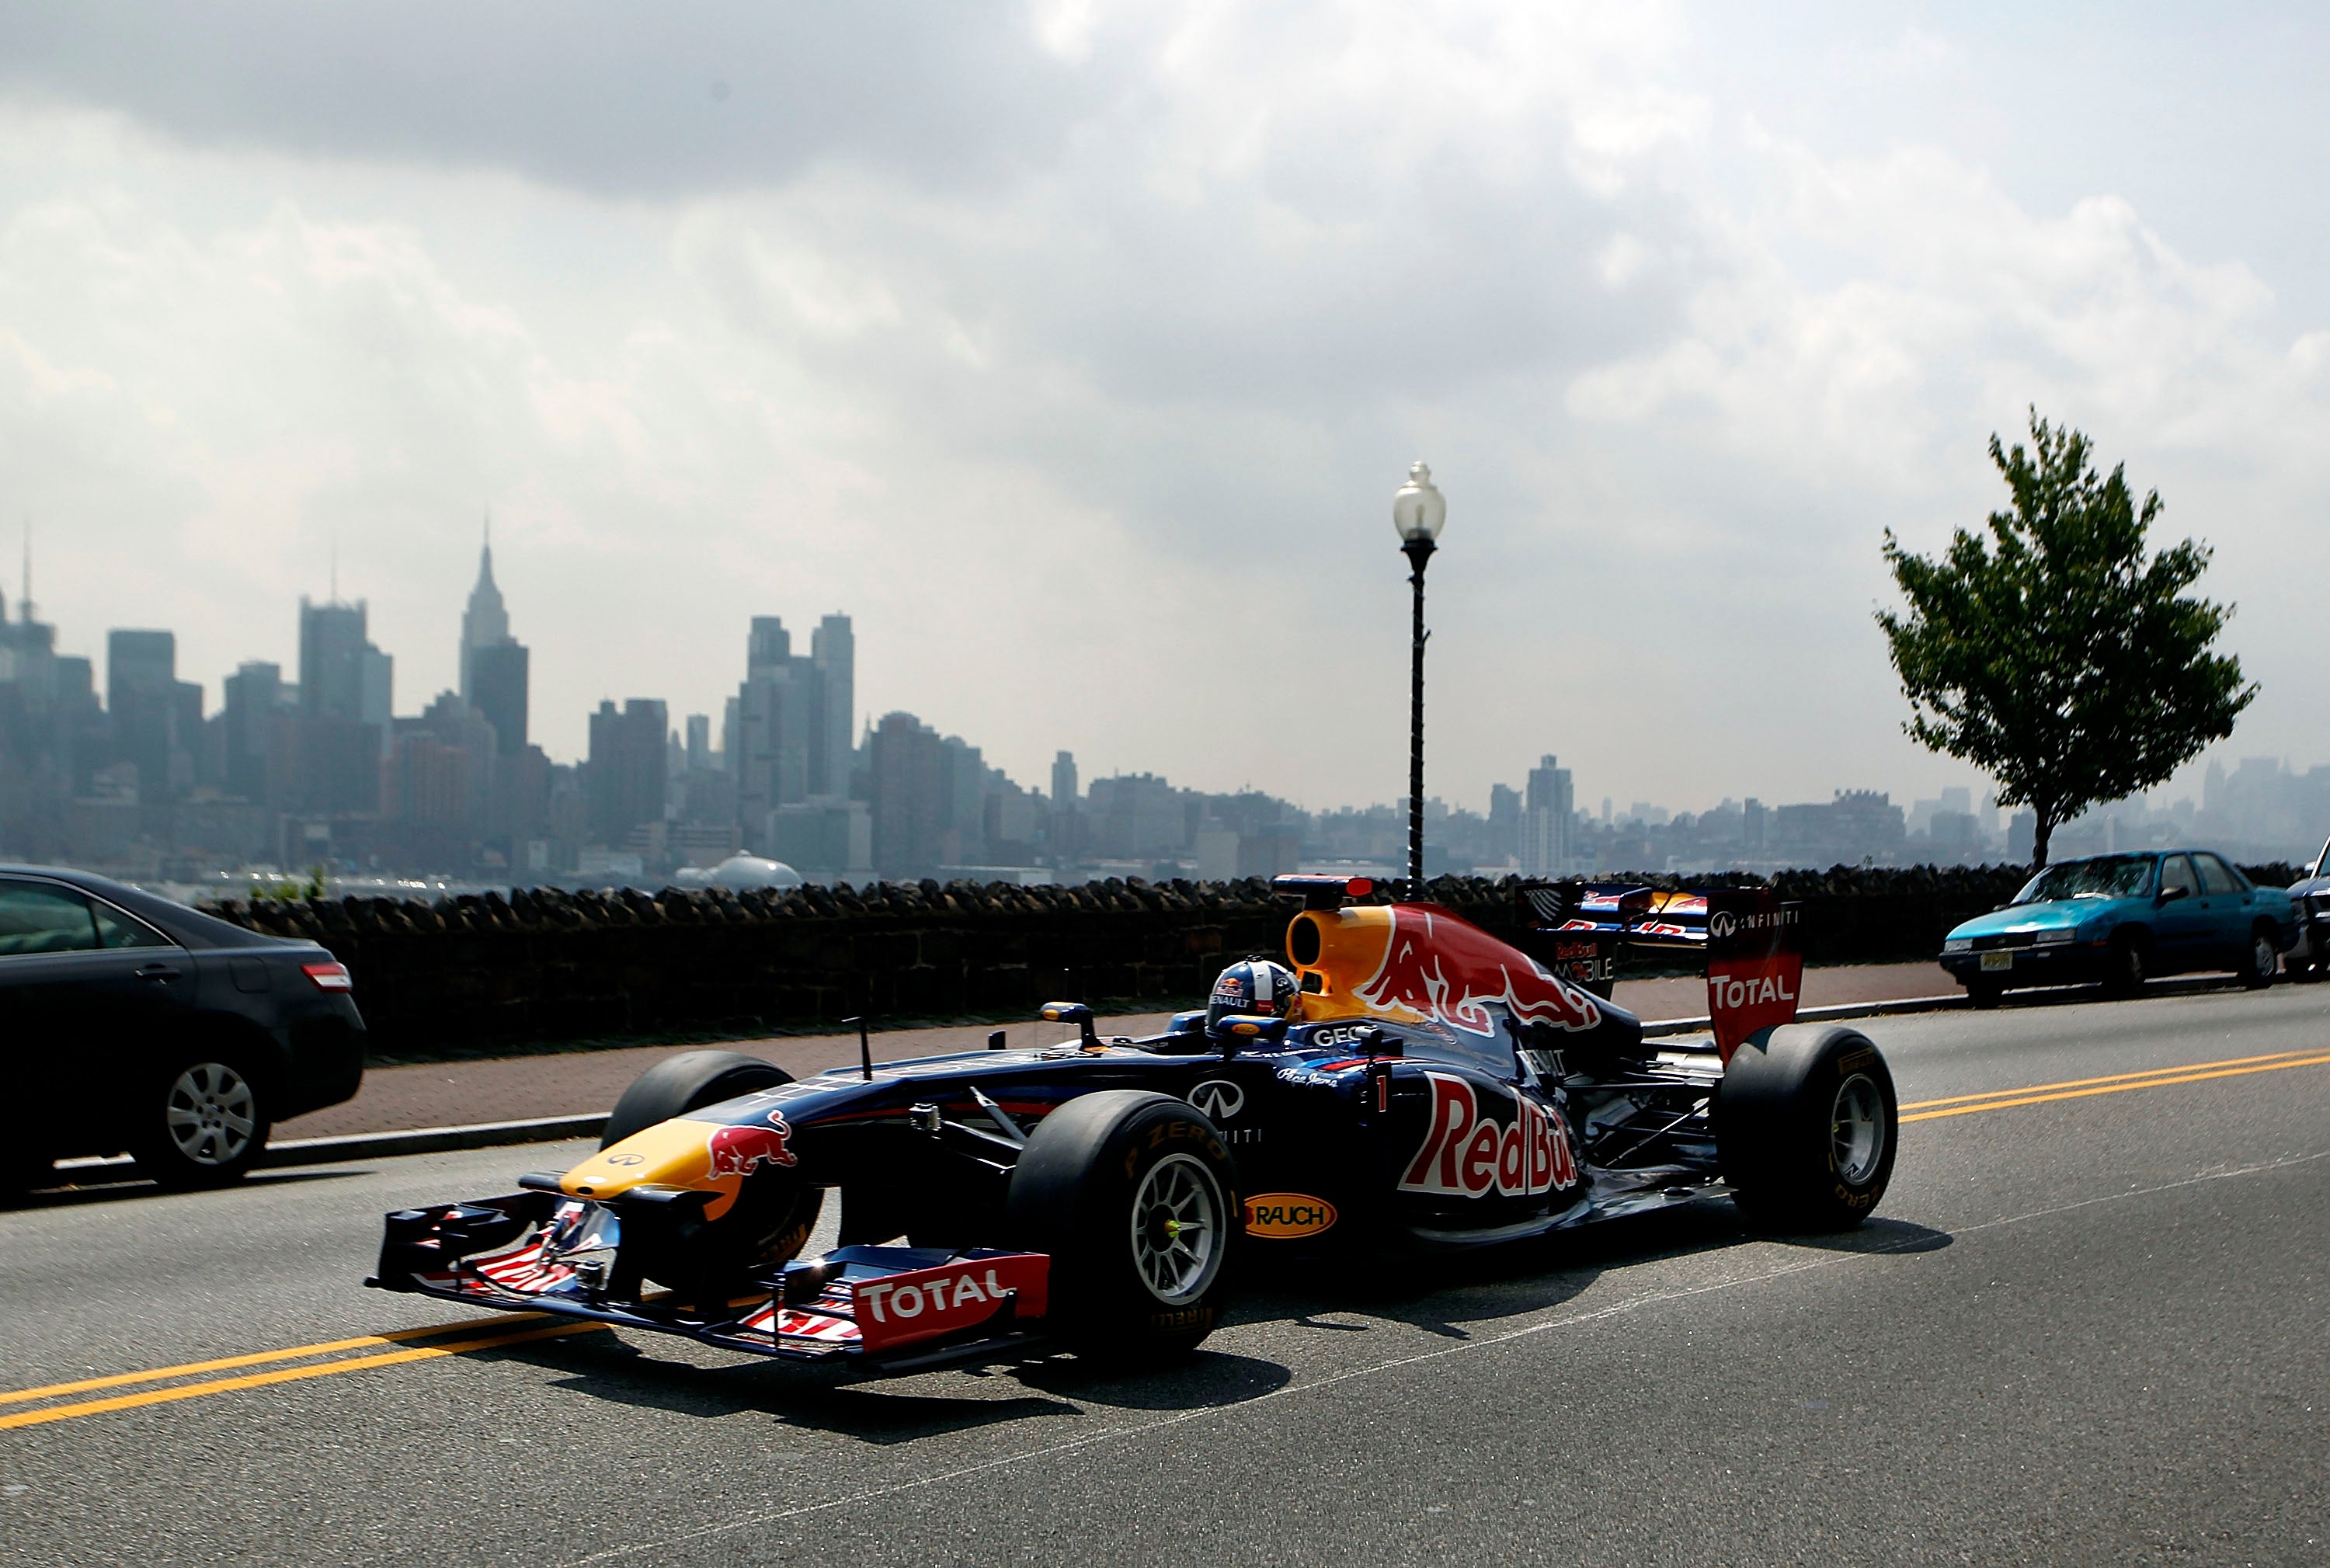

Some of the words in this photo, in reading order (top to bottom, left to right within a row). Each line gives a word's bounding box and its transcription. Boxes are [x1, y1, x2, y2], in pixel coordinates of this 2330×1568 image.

[1556, 941, 1574, 960] Red
[1576, 941, 1598, 958] Bull
[1553, 957, 1615, 983] MOBILE
[1709, 975, 1794, 1010] TOTAL
[1276, 1068, 1306, 1087] Pepe
[1306, 1073, 1339, 1088] Jeans
[1376, 1076, 1387, 1112] 1
[1145, 1120, 1229, 1163] ZERO
[1398, 1071, 1527, 1199] Red
[1256, 1206, 1324, 1226] RAUCH
[858, 1269, 1017, 1323] TOTAL
